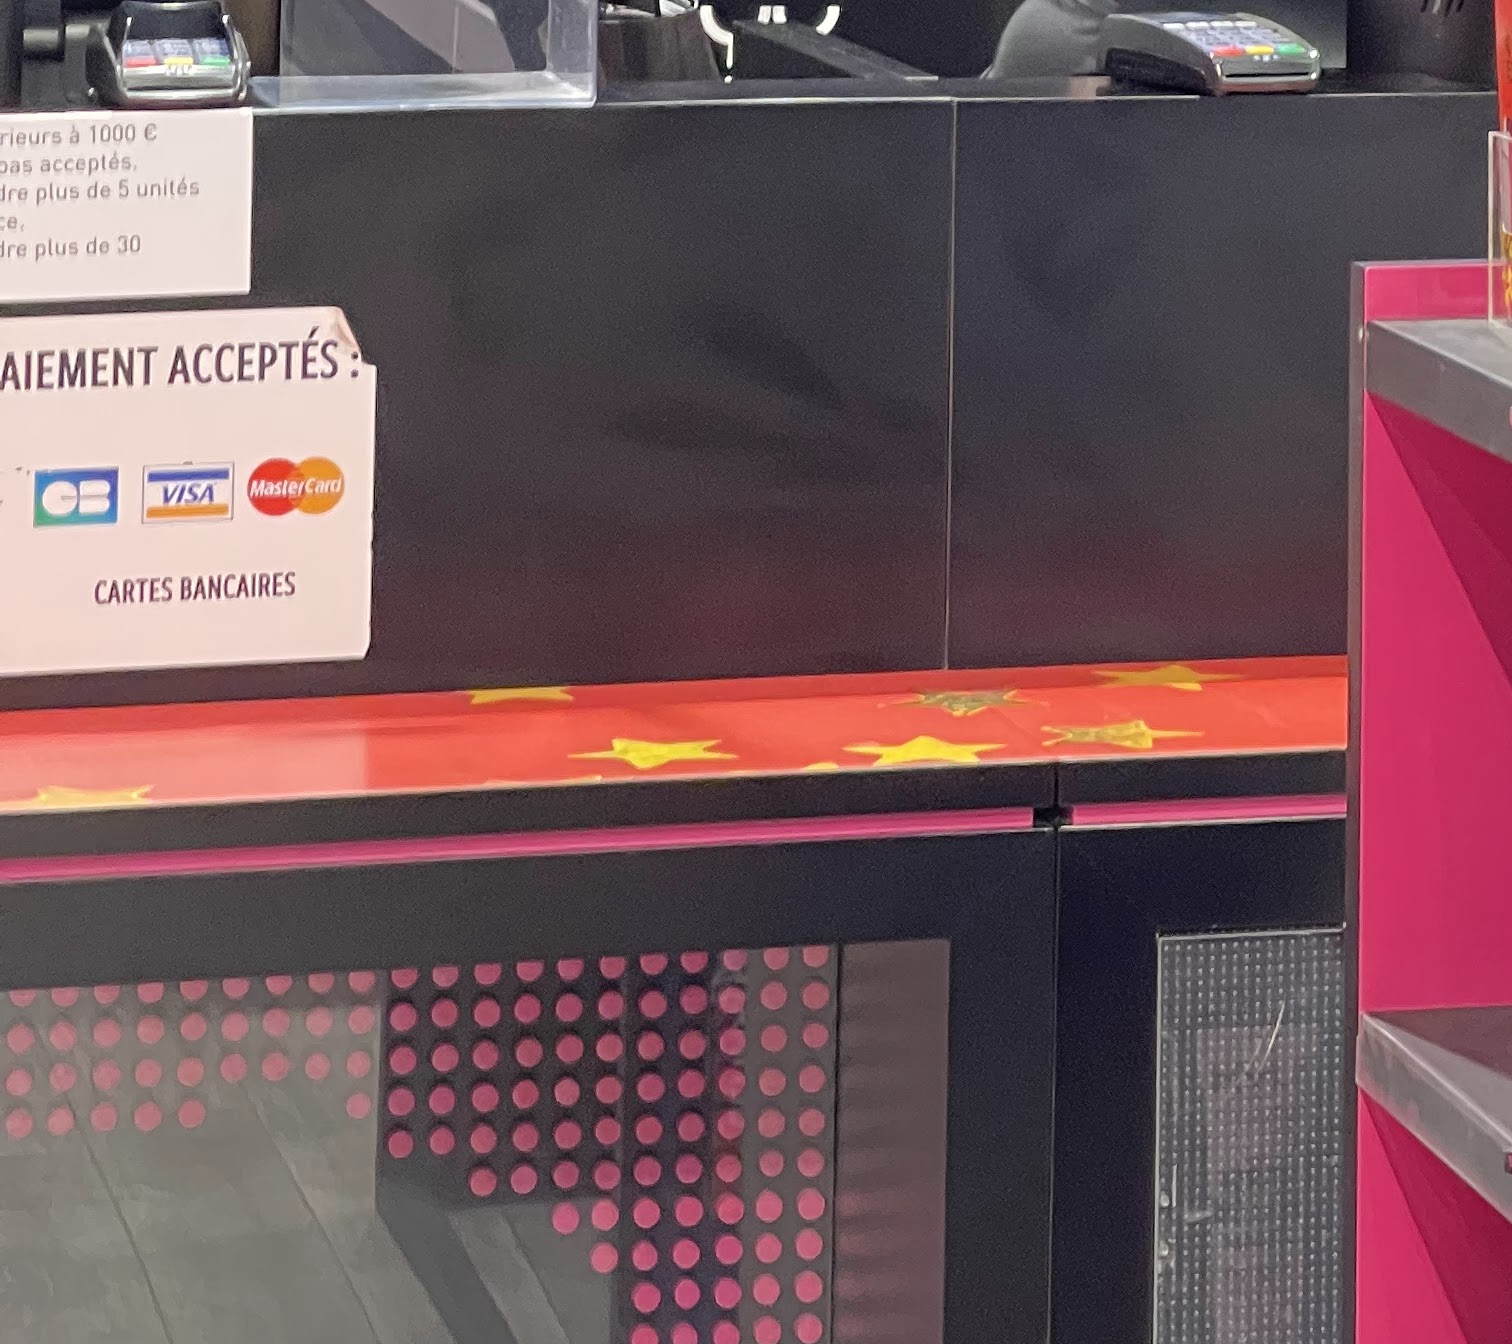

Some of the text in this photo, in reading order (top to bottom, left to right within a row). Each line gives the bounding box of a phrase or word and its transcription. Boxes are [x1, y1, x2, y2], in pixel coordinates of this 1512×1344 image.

[69, 124, 80, 144] à
[90, 123, 136, 144] 1000
[144, 123, 158, 142] €
[36, 182, 80, 206] plus
[86, 181, 111, 199] de
[118, 178, 129, 198] 5
[137, 172, 200, 198] unités
[35, 237, 79, 262] plus
[86, 235, 110, 256] de
[117, 234, 142, 254] 30
[0, 327, 361, 391] AIEMENT ACCEPTÉS :
[161, 483, 216, 506] VISA
[249, 476, 343, 499] MasterCard
[95, 572, 296, 605] CARTES BANCAIRES
